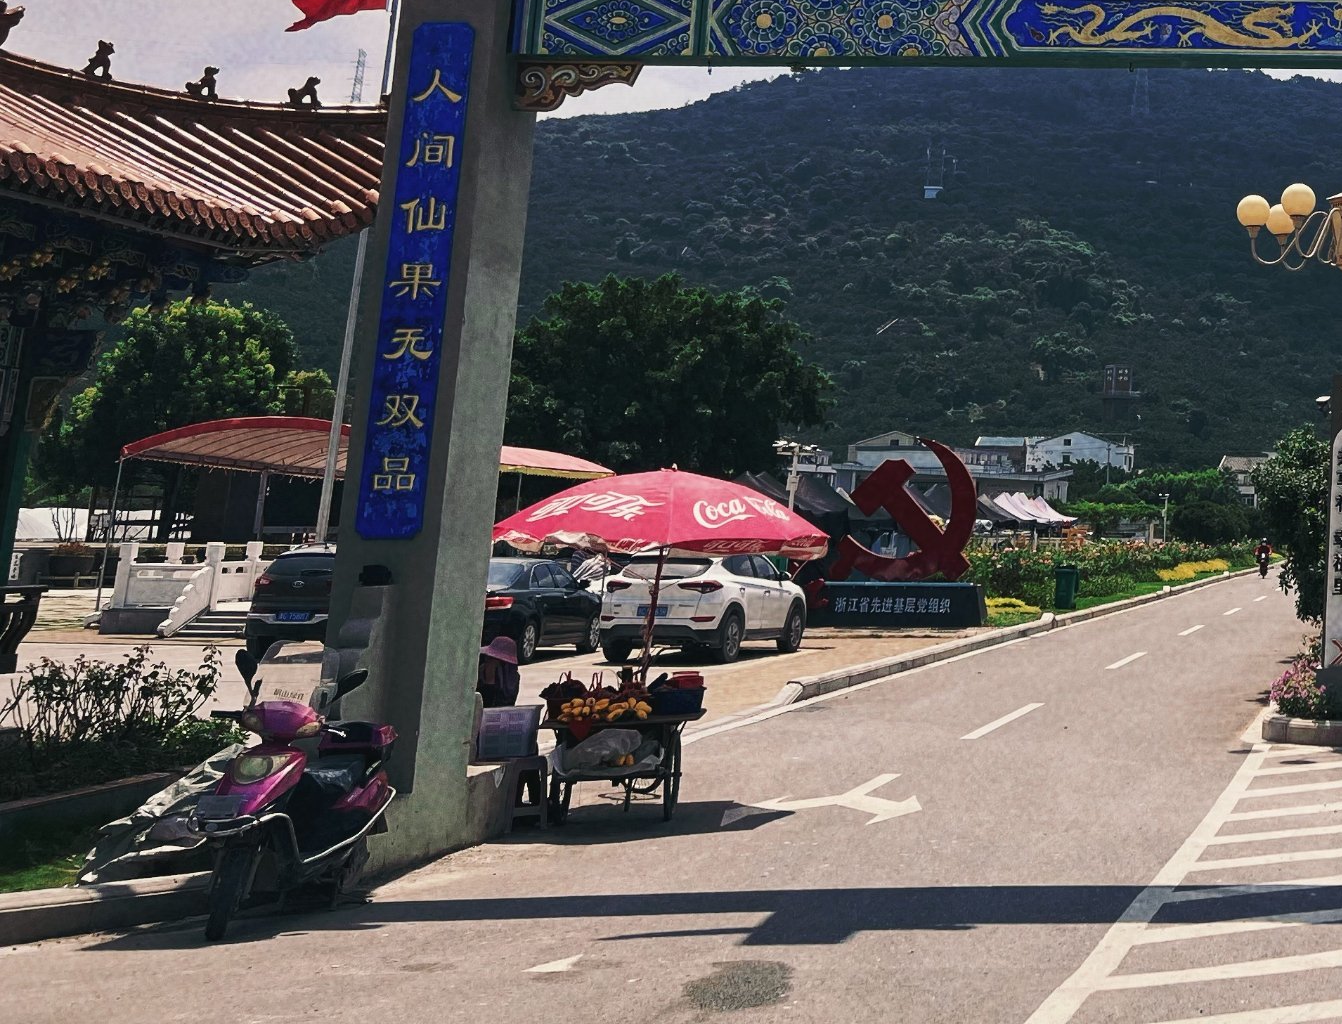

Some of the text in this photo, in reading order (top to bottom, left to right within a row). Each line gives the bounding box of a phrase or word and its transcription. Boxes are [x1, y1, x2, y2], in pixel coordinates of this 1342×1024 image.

[373, 68, 462, 492] 人间仙果无双品
[834, 597, 951, 613] 浙江省先进基层党组织
